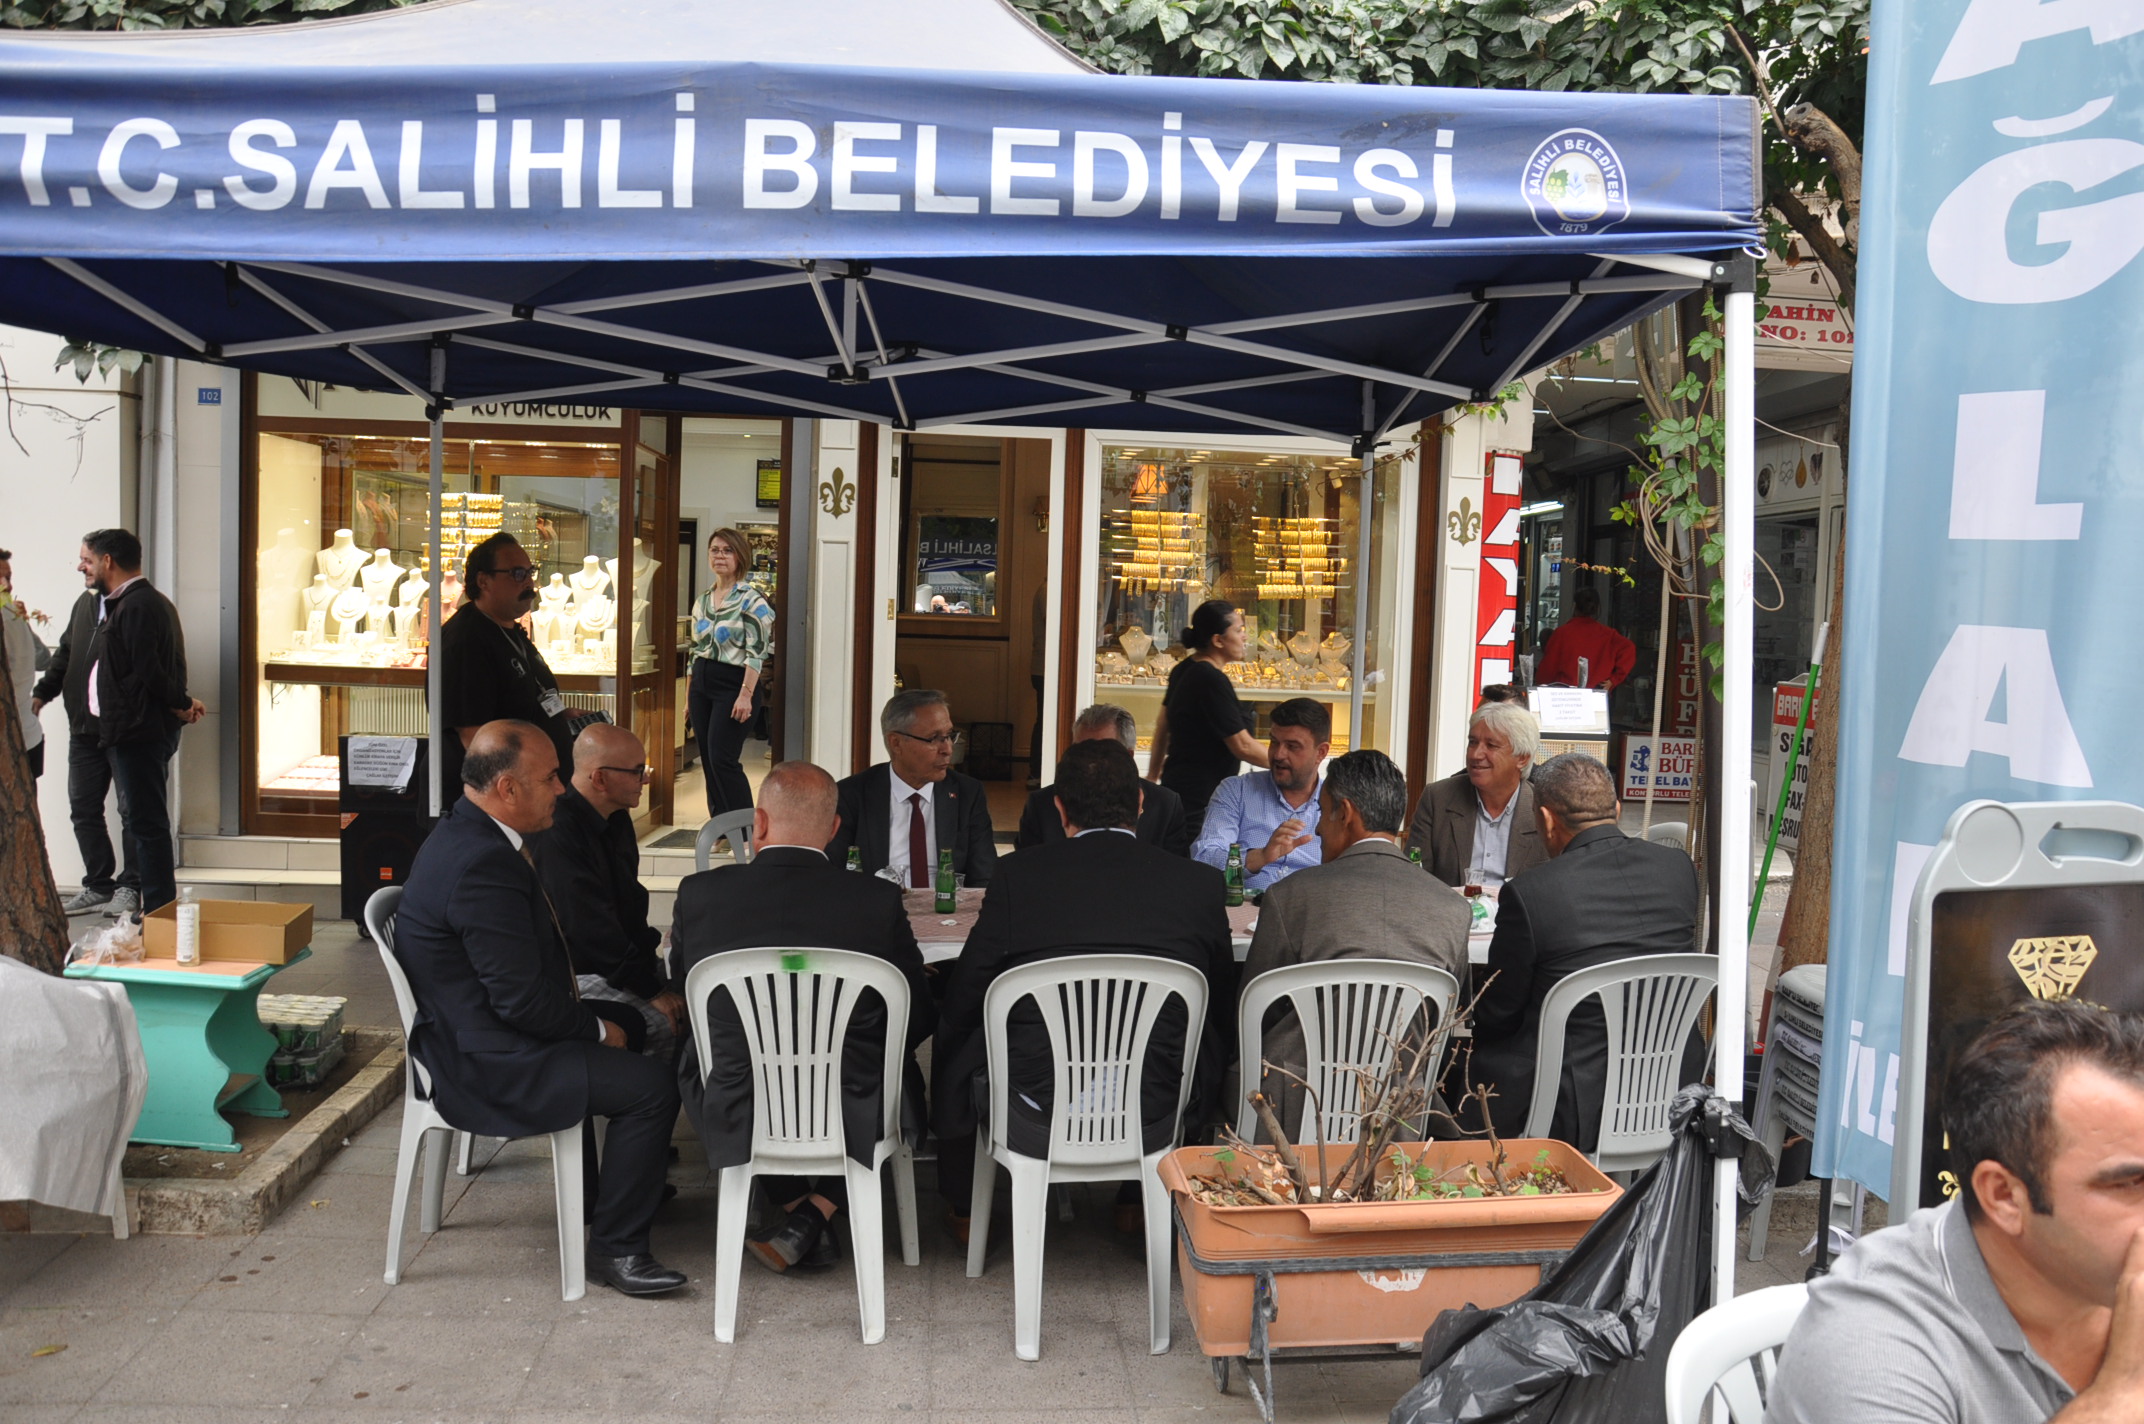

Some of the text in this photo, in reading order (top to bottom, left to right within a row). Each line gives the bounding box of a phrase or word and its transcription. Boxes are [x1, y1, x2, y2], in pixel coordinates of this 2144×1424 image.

[742, 111, 1456, 228] BELEDİYESİ
[1530, 142, 1561, 196] SALİHLİ
[1559, 222, 1588, 234] 1879
[1760, 325, 1806, 341] NO:
[202, 391, 219, 401] 102
[472, 402, 610, 420] KUYUMCULUK
[1661, 742, 1696, 755] BAR
[1630, 775, 1670, 786] TEEL
